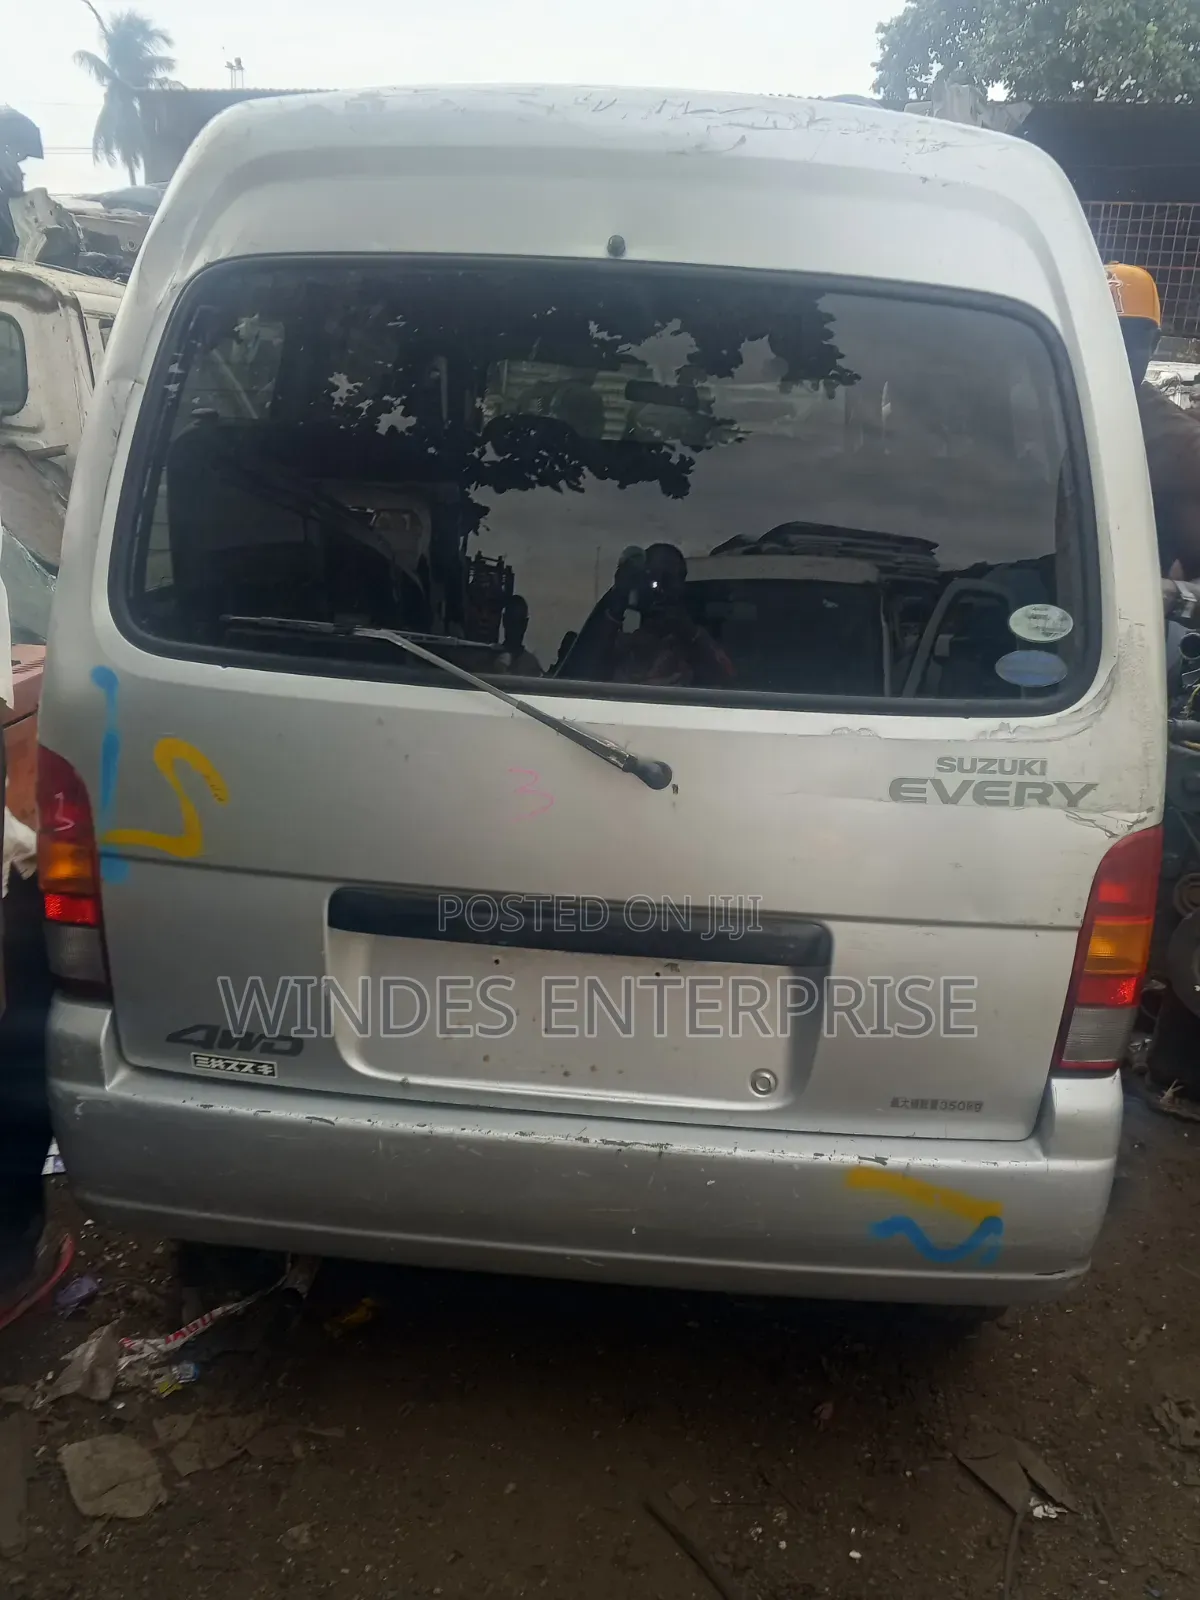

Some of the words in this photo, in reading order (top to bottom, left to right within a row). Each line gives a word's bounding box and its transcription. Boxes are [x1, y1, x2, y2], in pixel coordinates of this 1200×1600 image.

[936, 756, 1048, 777] SUZUKI
[888, 777, 1099, 808] EVERY
[165, 1024, 303, 1056] 4WD
